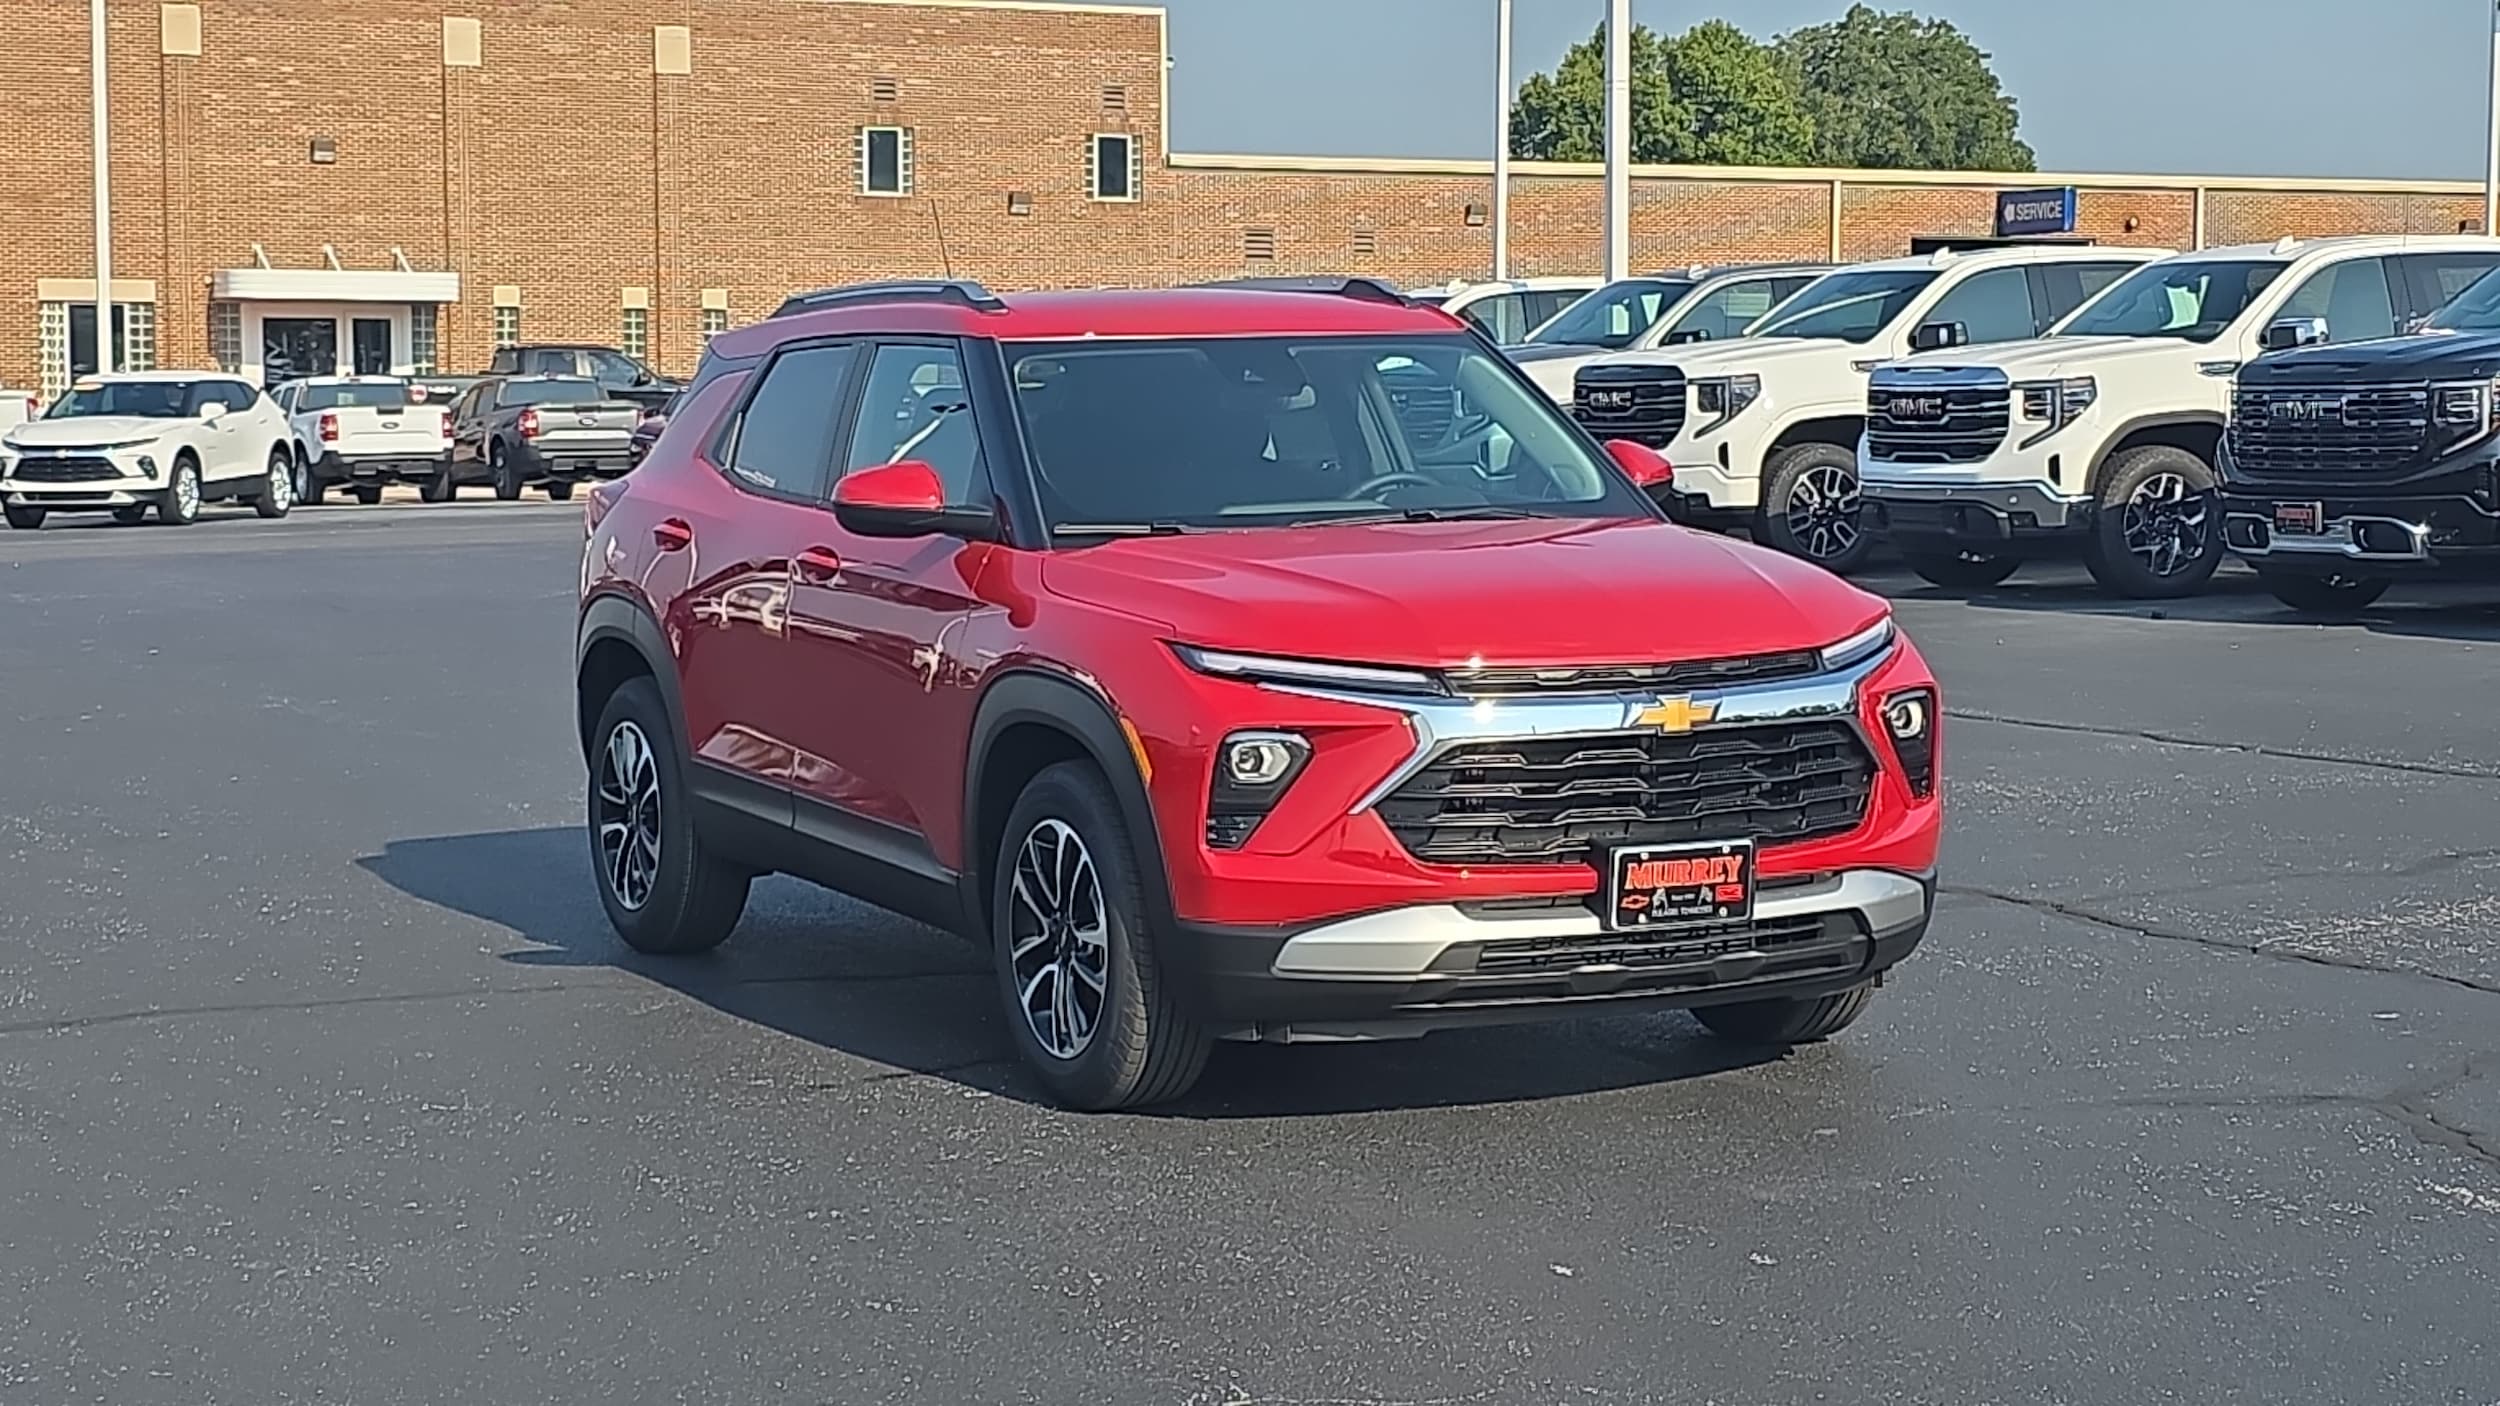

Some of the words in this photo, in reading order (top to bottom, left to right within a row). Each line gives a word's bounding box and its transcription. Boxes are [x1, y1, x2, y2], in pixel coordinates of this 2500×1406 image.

[2015, 201, 2063, 221] SERVICE
[1589, 391, 1632, 407] GMC
[1890, 398, 1942, 416] GMC
[2269, 401, 2341, 420] GMC
[1624, 855, 1743, 889] MURREY
